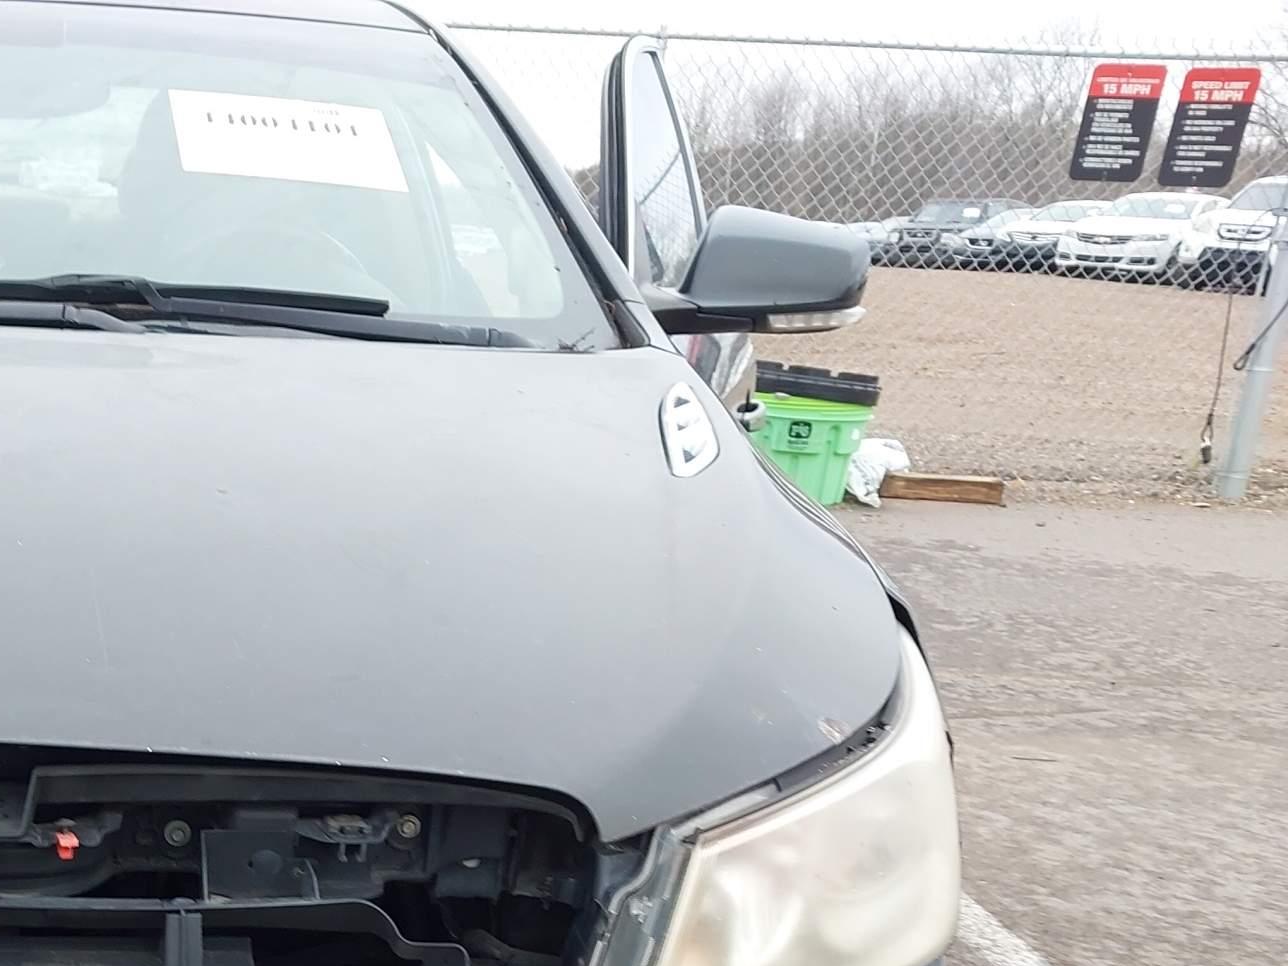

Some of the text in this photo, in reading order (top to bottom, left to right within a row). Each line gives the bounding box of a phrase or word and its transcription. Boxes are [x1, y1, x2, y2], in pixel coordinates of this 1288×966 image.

[1103, 84, 1151, 95] 15 MPH
[1191, 81, 1223, 90] SPEED
[1194, 91, 1244, 102] 15 MPH
